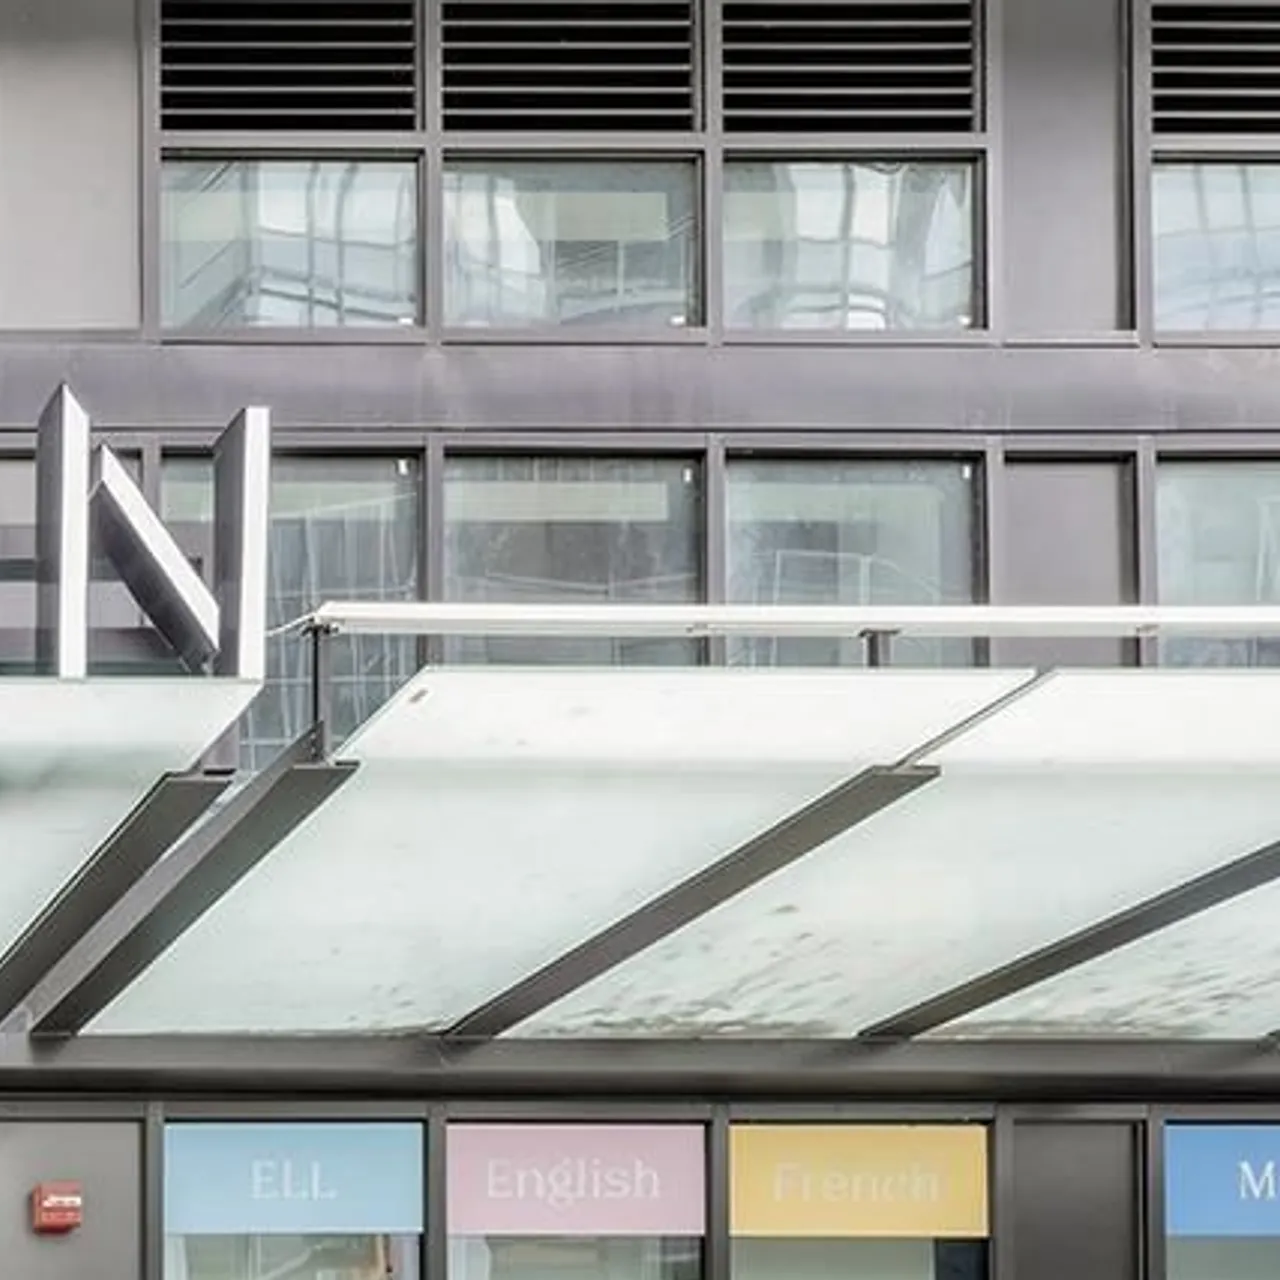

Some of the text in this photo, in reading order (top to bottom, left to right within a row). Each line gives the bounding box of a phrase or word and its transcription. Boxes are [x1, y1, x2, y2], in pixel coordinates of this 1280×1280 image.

[251, 1160, 338, 1200] ELL
[487, 1157, 661, 1213] English
[773, 1161, 943, 1202] French
